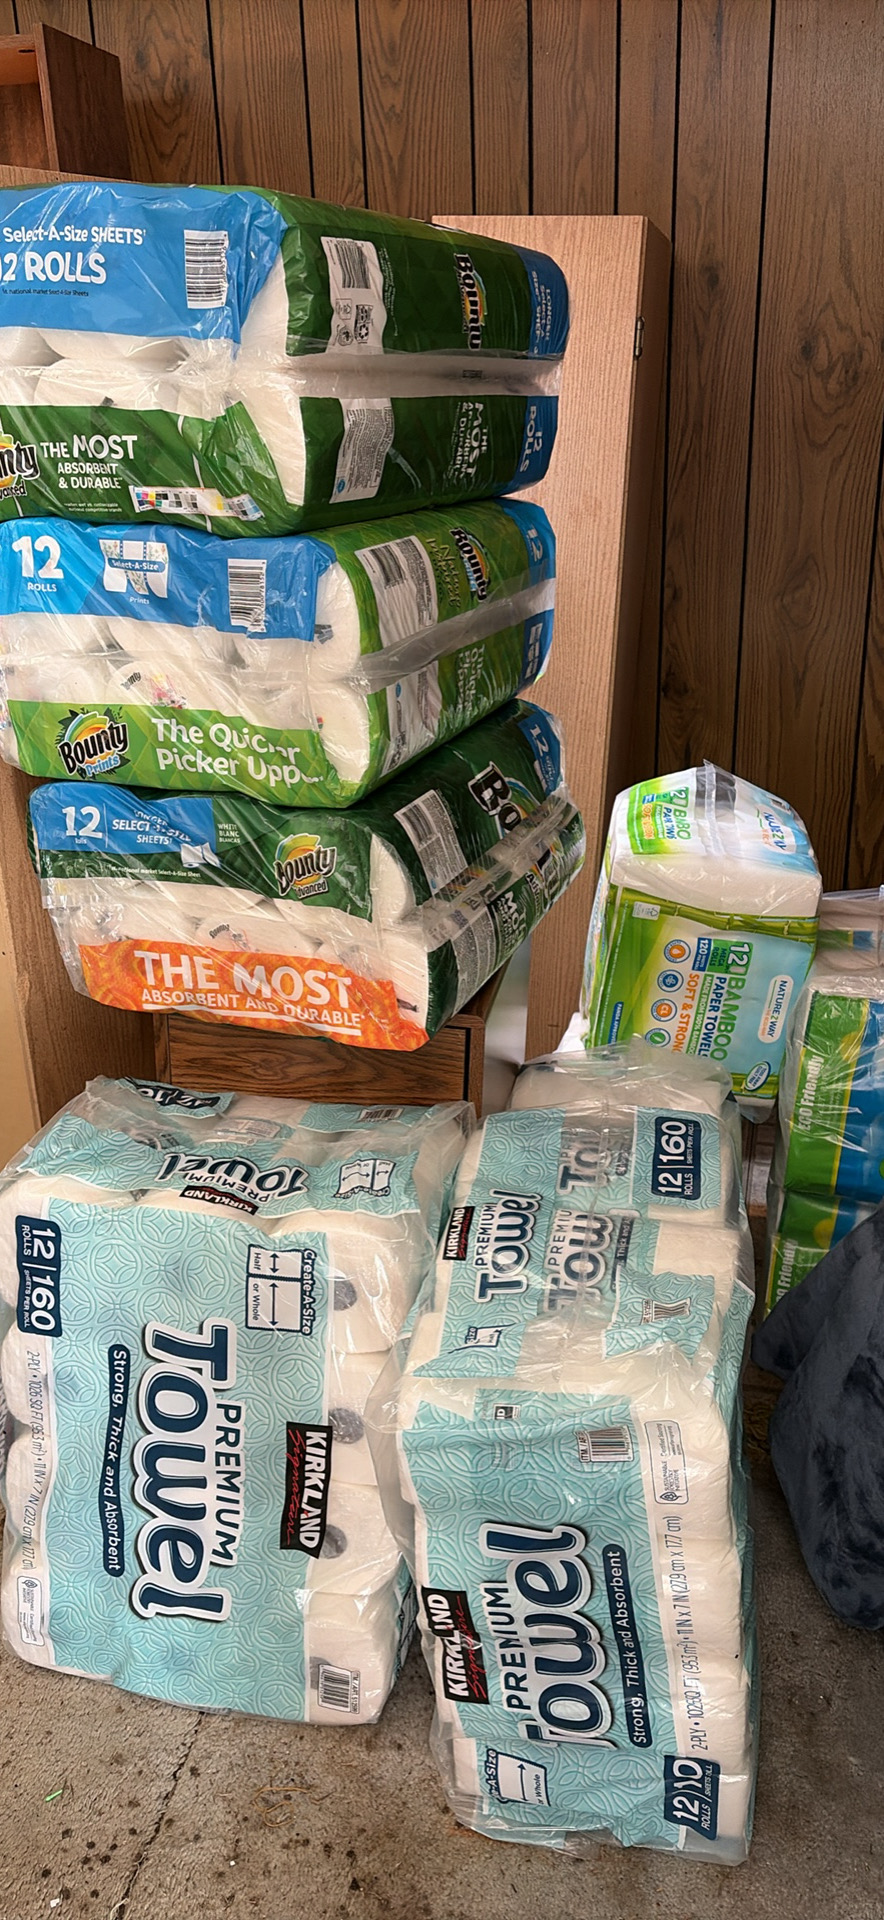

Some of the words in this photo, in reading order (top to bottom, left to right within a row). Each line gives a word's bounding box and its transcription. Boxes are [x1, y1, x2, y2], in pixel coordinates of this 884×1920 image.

[3, 225, 88, 242] Select-A-Size
[0, 253, 17, 280] 2
[25, 251, 106, 284] ROLLS
[40, 442, 70, 458] THE
[73, 434, 138, 459] MOST
[466, 402, 485, 478] MOST
[519, 405, 537, 472] ROLLS
[57, 462, 118, 475] ABSORBENT
[58, 477, 68, 489] &
[12, 535, 64, 579] 12
[27, 582, 57, 592] ROLLS
[129, 596, 150, 605] Prints
[151, 717, 204, 744] The
[530, 724, 549, 757] 12
[59, 722, 129, 774] Bounty
[155, 748, 240, 777] Picker
[86, 753, 121, 777] Prints
[62, 806, 102, 839] 12
[274, 846, 338, 896] Bounty
[698, 939, 709, 955] 120
[727, 943, 750, 966] 12
[134, 950, 220, 990] THE
[232, 961, 352, 1008] MOST
[684, 973, 700, 1001] SOFT
[141, 989, 240, 1008] ABSORBENT
[245, 997, 279, 1012] AND
[682, 1002, 693, 1011] &
[709, 976, 727, 1013] PAPER
[709, 976, 746, 1061] BAMBOO
[800, 1055, 825, 1107] Friendly
[659, 1121, 687, 1163] 160
[158, 1153, 311, 1199] Towel
[184, 1172, 271, 1202] PREMIUM
[657, 1172, 682, 1193] 12
[684, 1173, 693, 1196] ROLLS
[183, 1187, 256, 1213] KIRKLAND
[21, 1224, 31, 1256] ROLLS
[32, 1228, 56, 1259] 12
[446, 1208, 465, 1258] KIRKLAND
[475, 1204, 497, 1267] PREMIUM
[478, 1189, 542, 1300] Towel
[548, 1209, 573, 1267] PREMIU
[253, 1252, 262, 1271] Half
[31, 1275, 56, 1331] 160
[253, 1283, 260, 1293] or
[302, 1249, 317, 1334] Create-A-Size
[252, 1294, 260, 1321] Whole
[27, 1350, 41, 1373] 2-PLY
[111, 1350, 127, 1408] Strong,
[30, 1398, 43, 1410] SQ
[106, 1416, 123, 1461] Thick
[103, 1467, 117, 1497] and
[135, 1322, 232, 1617] Towel
[211, 1403, 242, 1561] PREMIUM
[28, 1494, 40, 1506] IN
[285, 1429, 304, 1546] Signature
[299, 1431, 328, 1549] KIRKLAND
[103, 1500, 121, 1571] Absorbent
[662, 1516, 683, 1532] cm)
[671, 1560, 685, 1572] cm
[606, 1551, 629, 1628] Absorbent
[669, 1573, 690, 1593] (27.9
[672, 1594, 690, 1602] IN
[675, 1619, 693, 1628] IN
[484, 1587, 532, 1710] PREMIUM
[617, 1631, 635, 1649] and
[622, 1650, 640, 1687] Thick
[630, 1692, 647, 1744] Strong,
[692, 1728, 708, 1750] 2-PLY
[533, 1774, 542, 1797] Whole
[672, 1796, 699, 1821] 12
[701, 1804, 711, 1831] ROLLS
